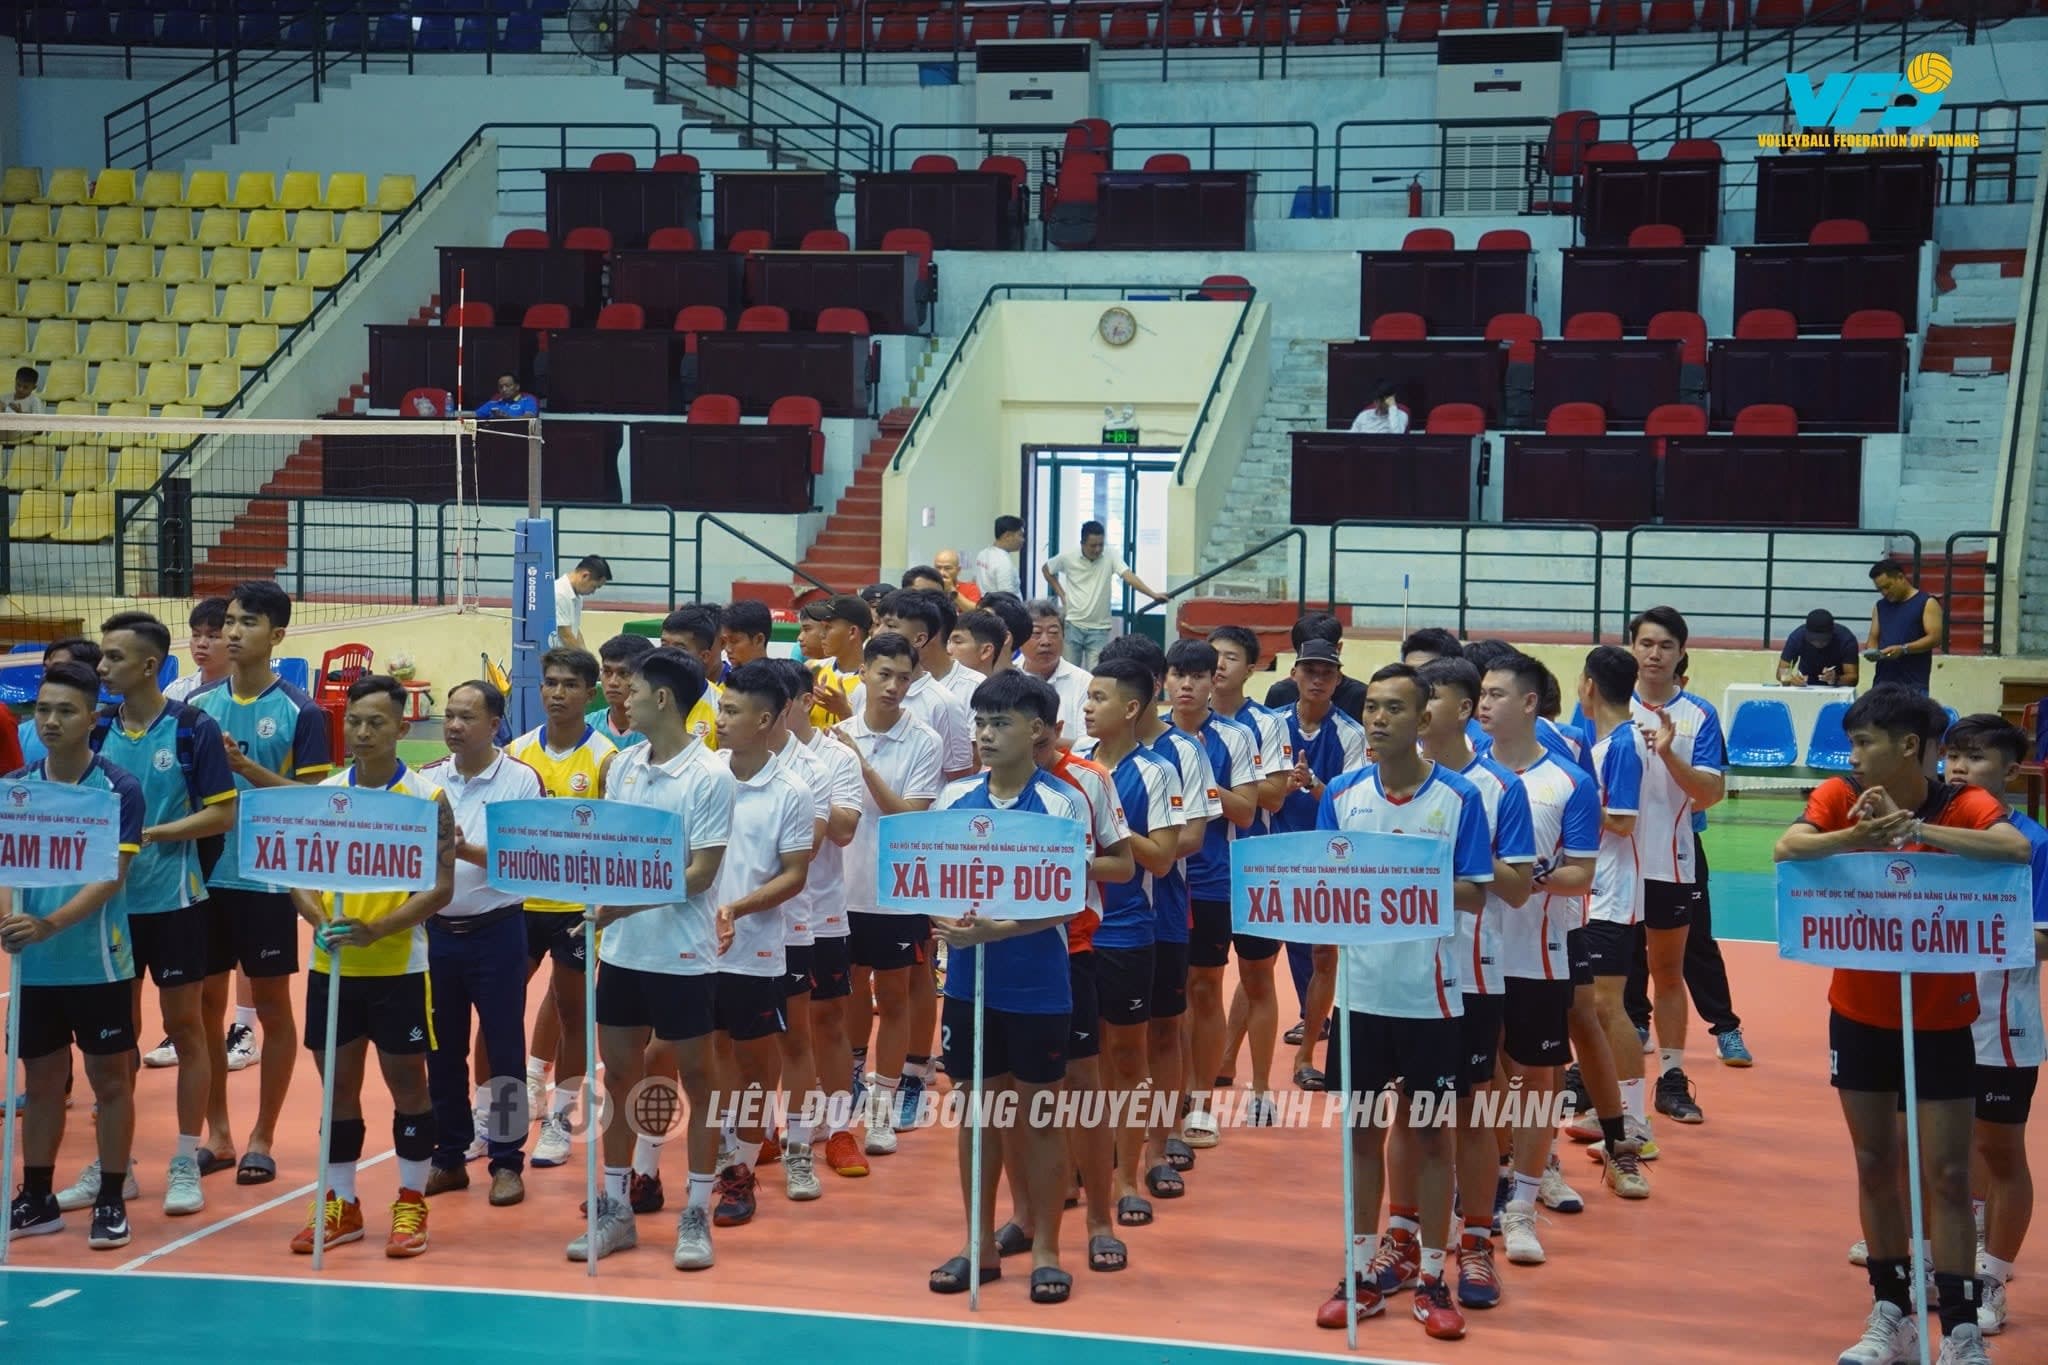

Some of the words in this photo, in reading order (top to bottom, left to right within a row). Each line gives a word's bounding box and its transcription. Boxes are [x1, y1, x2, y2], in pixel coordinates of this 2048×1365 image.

[50, 830, 87, 870] MỸ
[255, 830, 287, 870] XÃ
[295, 832, 340, 873] TÂY
[347, 842, 422, 879] GIANG
[498, 844, 560, 882] PHƯỜNG
[564, 850, 600, 891] ĐIỆN
[606, 851, 636, 888] BÀN
[642, 850, 673, 890] BẮC
[892, 856, 930, 897] XÃ
[940, 857, 1004, 907] HIỆP
[1014, 859, 1071, 901] ĐỨC
[1248, 880, 1284, 922] XÃ
[1294, 880, 1370, 924] NÔNG
[1380, 885, 1439, 925] SƠN
[1876, 890, 1896, 898] THÀNH
[1898, 890, 1912, 899] PHỐ
[1983, 892, 1998, 901] NĂM
[1802, 910, 1903, 953] PHƯỜNG
[1911, 905, 1968, 954] CẨM
[1978, 914, 2006, 963] LỆ
